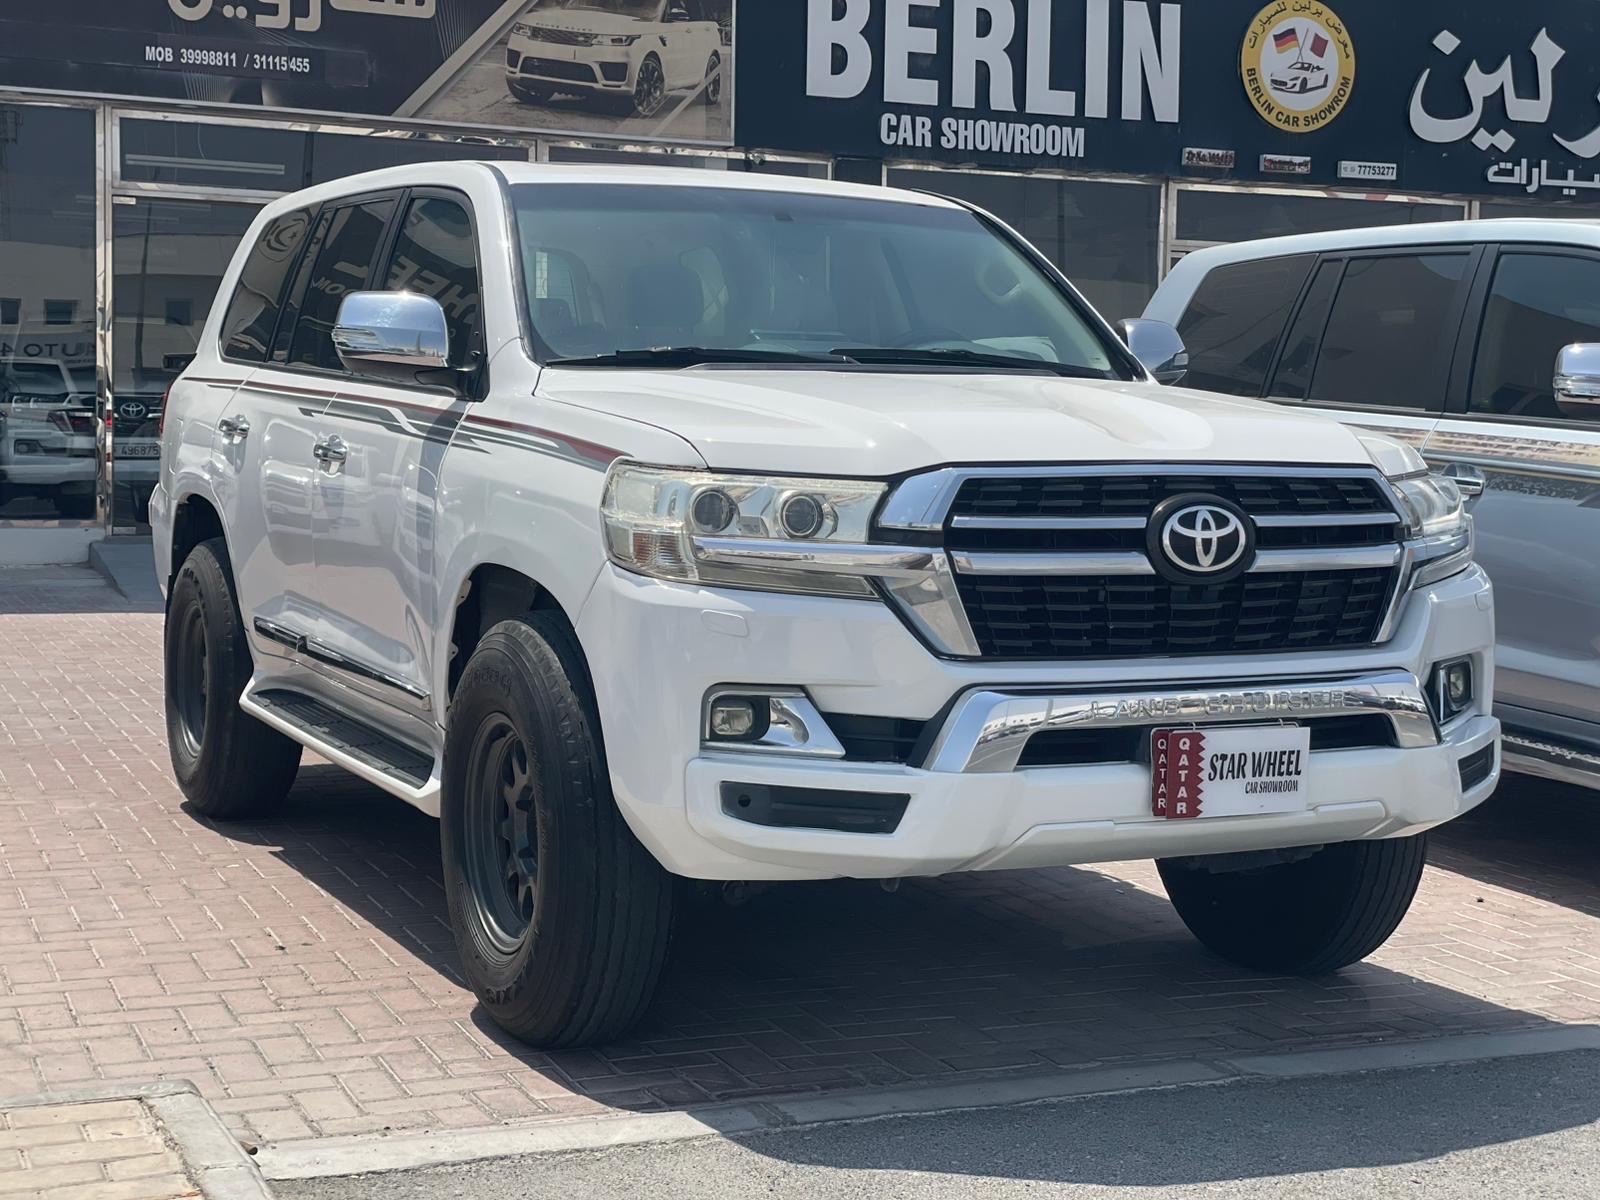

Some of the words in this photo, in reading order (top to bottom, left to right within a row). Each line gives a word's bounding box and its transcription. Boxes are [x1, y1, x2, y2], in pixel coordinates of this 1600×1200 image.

[145, 46, 173, 63] MOB
[180, 48, 237, 67] 39998811
[253, 54, 310, 73] 31115455
[805, 0, 1182, 123] BERLIN
[1246, 67, 1275, 115] BERLIN
[1275, 111, 1300, 127] CAR
[1303, 76, 1351, 127] SHOWROM
[880, 113, 932, 148] CAR
[940, 117, 1085, 158] SHOWROOM
[1358, 165, 1395, 176] 77753277
[1091, 698, 1181, 719] LAND
[1157, 738, 1167, 809] QATAR
[1176, 737, 1191, 815] QATAR
[1208, 752, 1248, 781] STAR
[1251, 749, 1302, 778] WHEEL
[1245, 781, 1261, 794] CAR
[1258, 780, 1299, 794] SHOWROOM
